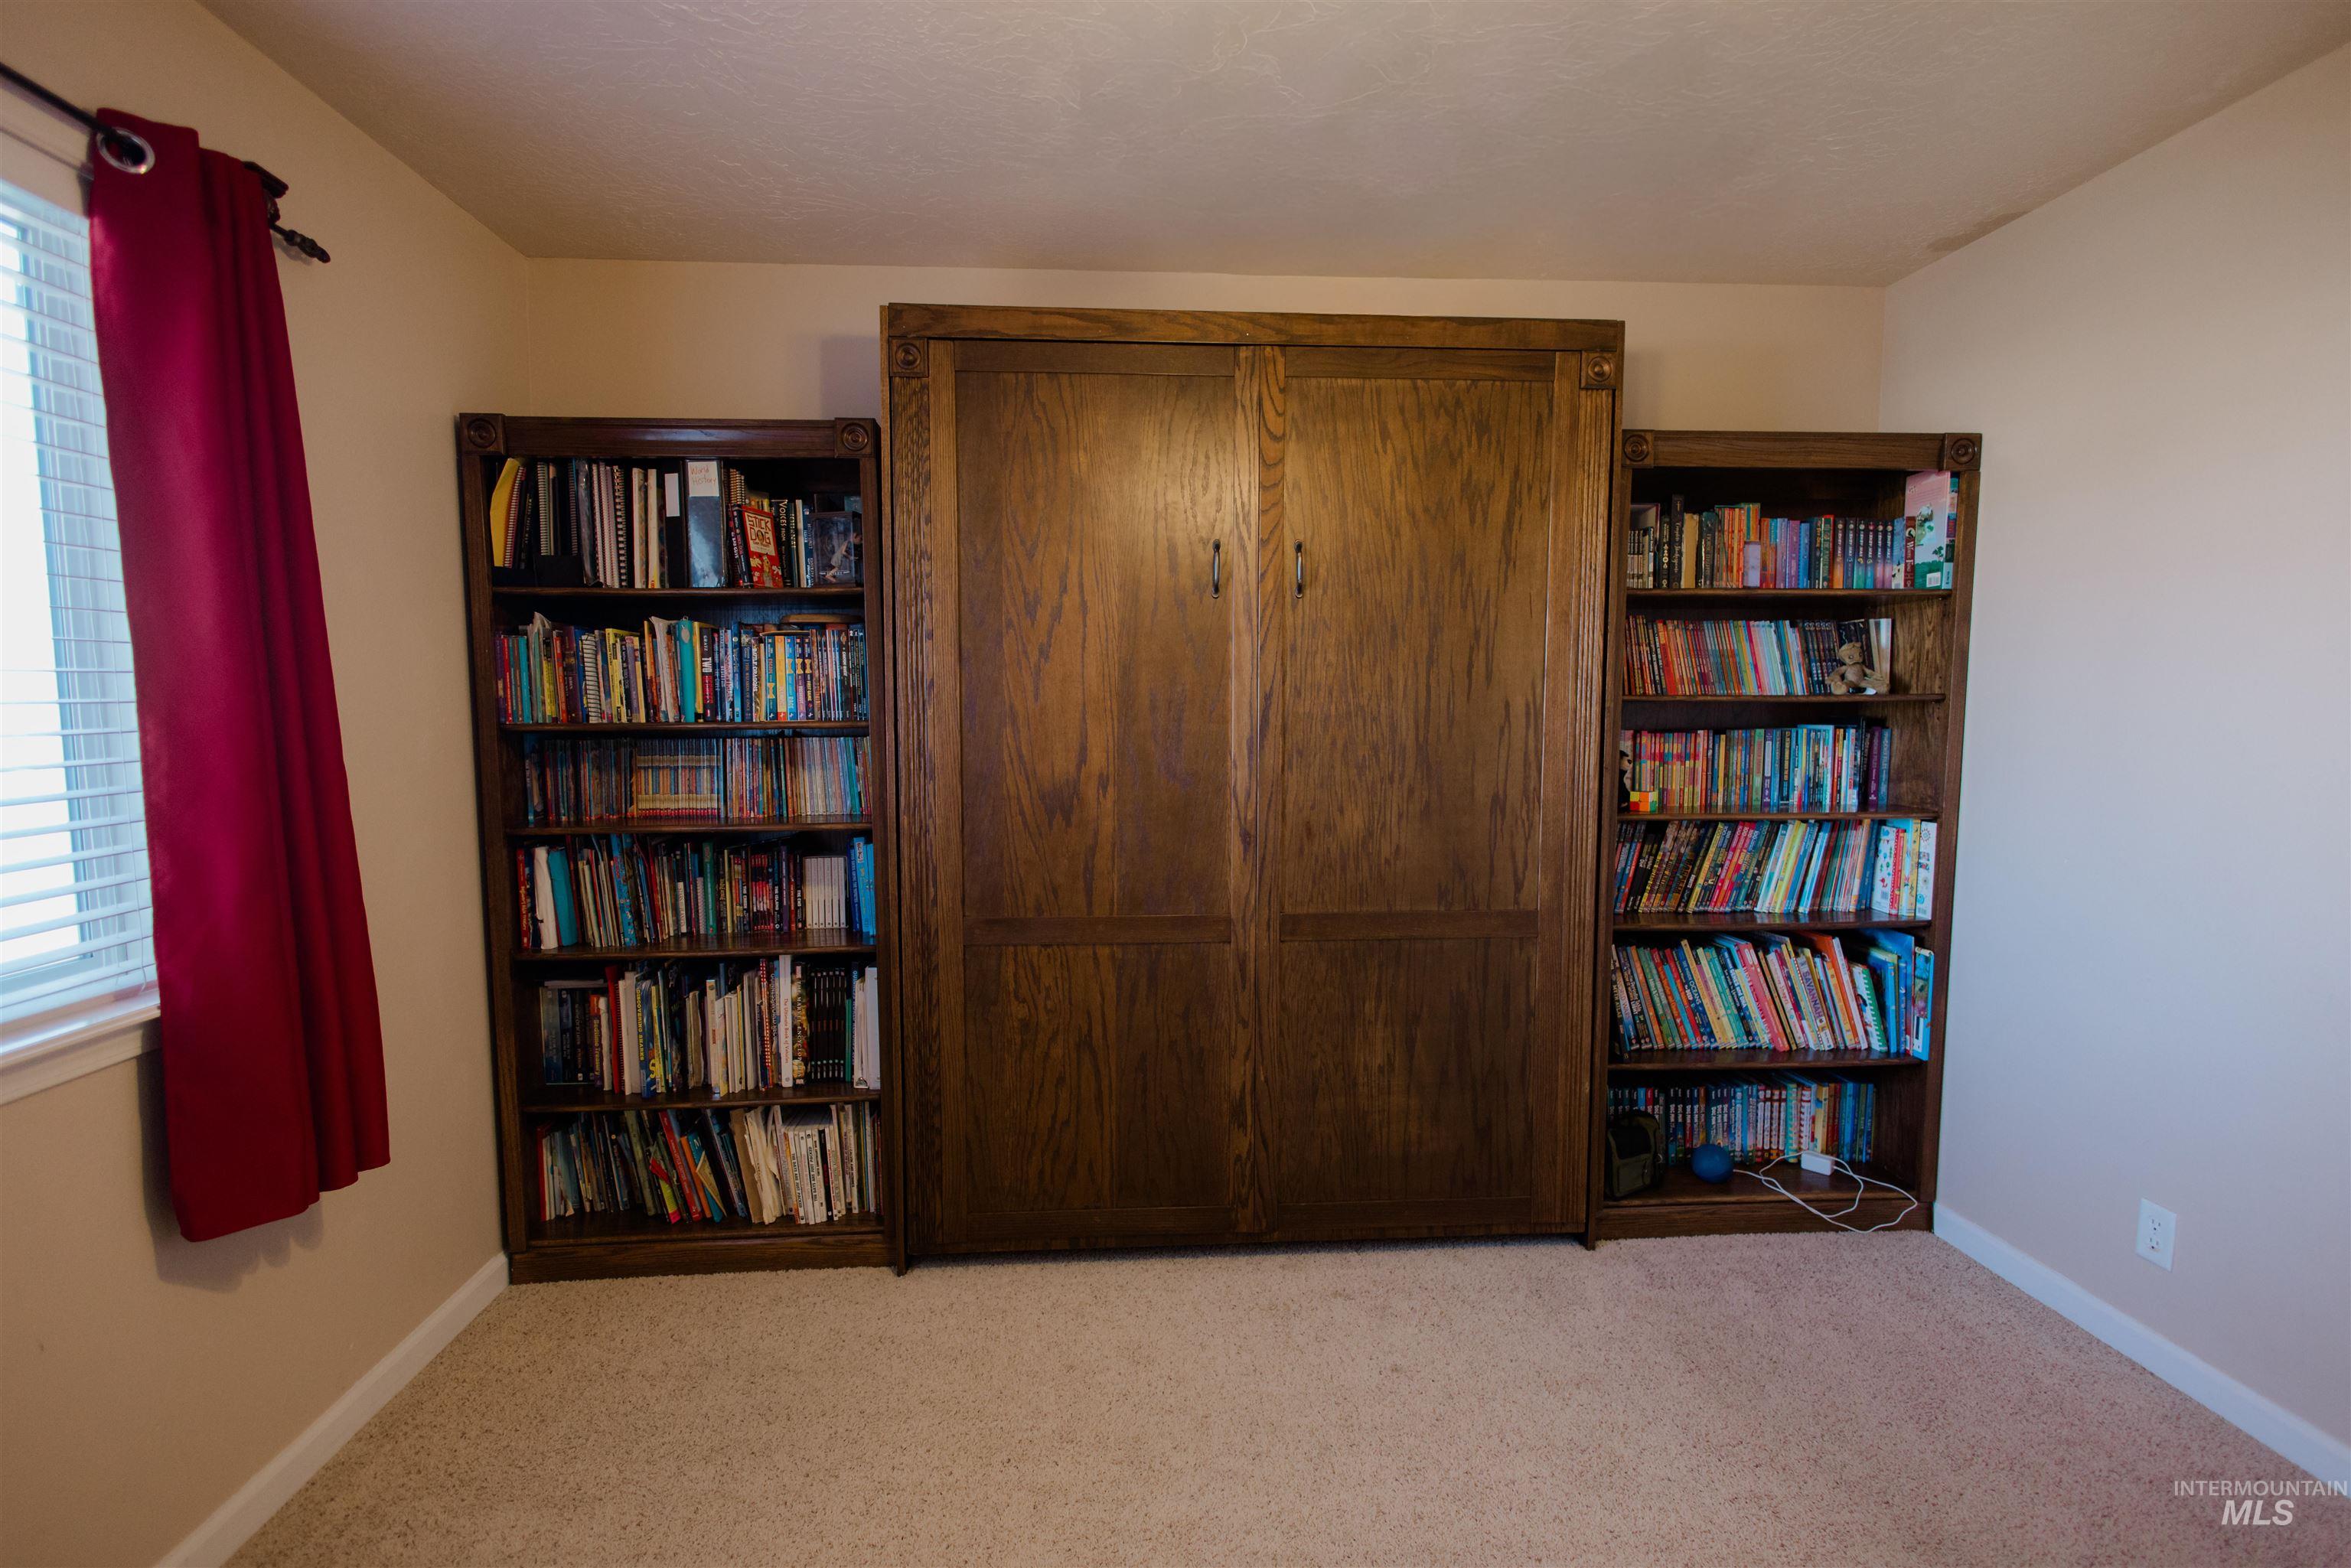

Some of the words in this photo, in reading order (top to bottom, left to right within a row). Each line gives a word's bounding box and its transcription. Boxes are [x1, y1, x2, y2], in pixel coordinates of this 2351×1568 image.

[690, 465, 710, 479] World
[692, 475, 718, 488] History
[747, 513, 770, 533] STICK
[778, 501, 788, 526] VOICES
[750, 530, 771, 545] DOG
[701, 657, 712, 673] TWO
[1687, 980, 1702, 1006] OCEANS
[1802, 970, 1823, 1019] SAVANNAH
[593, 1047, 602, 1075] Treasury
